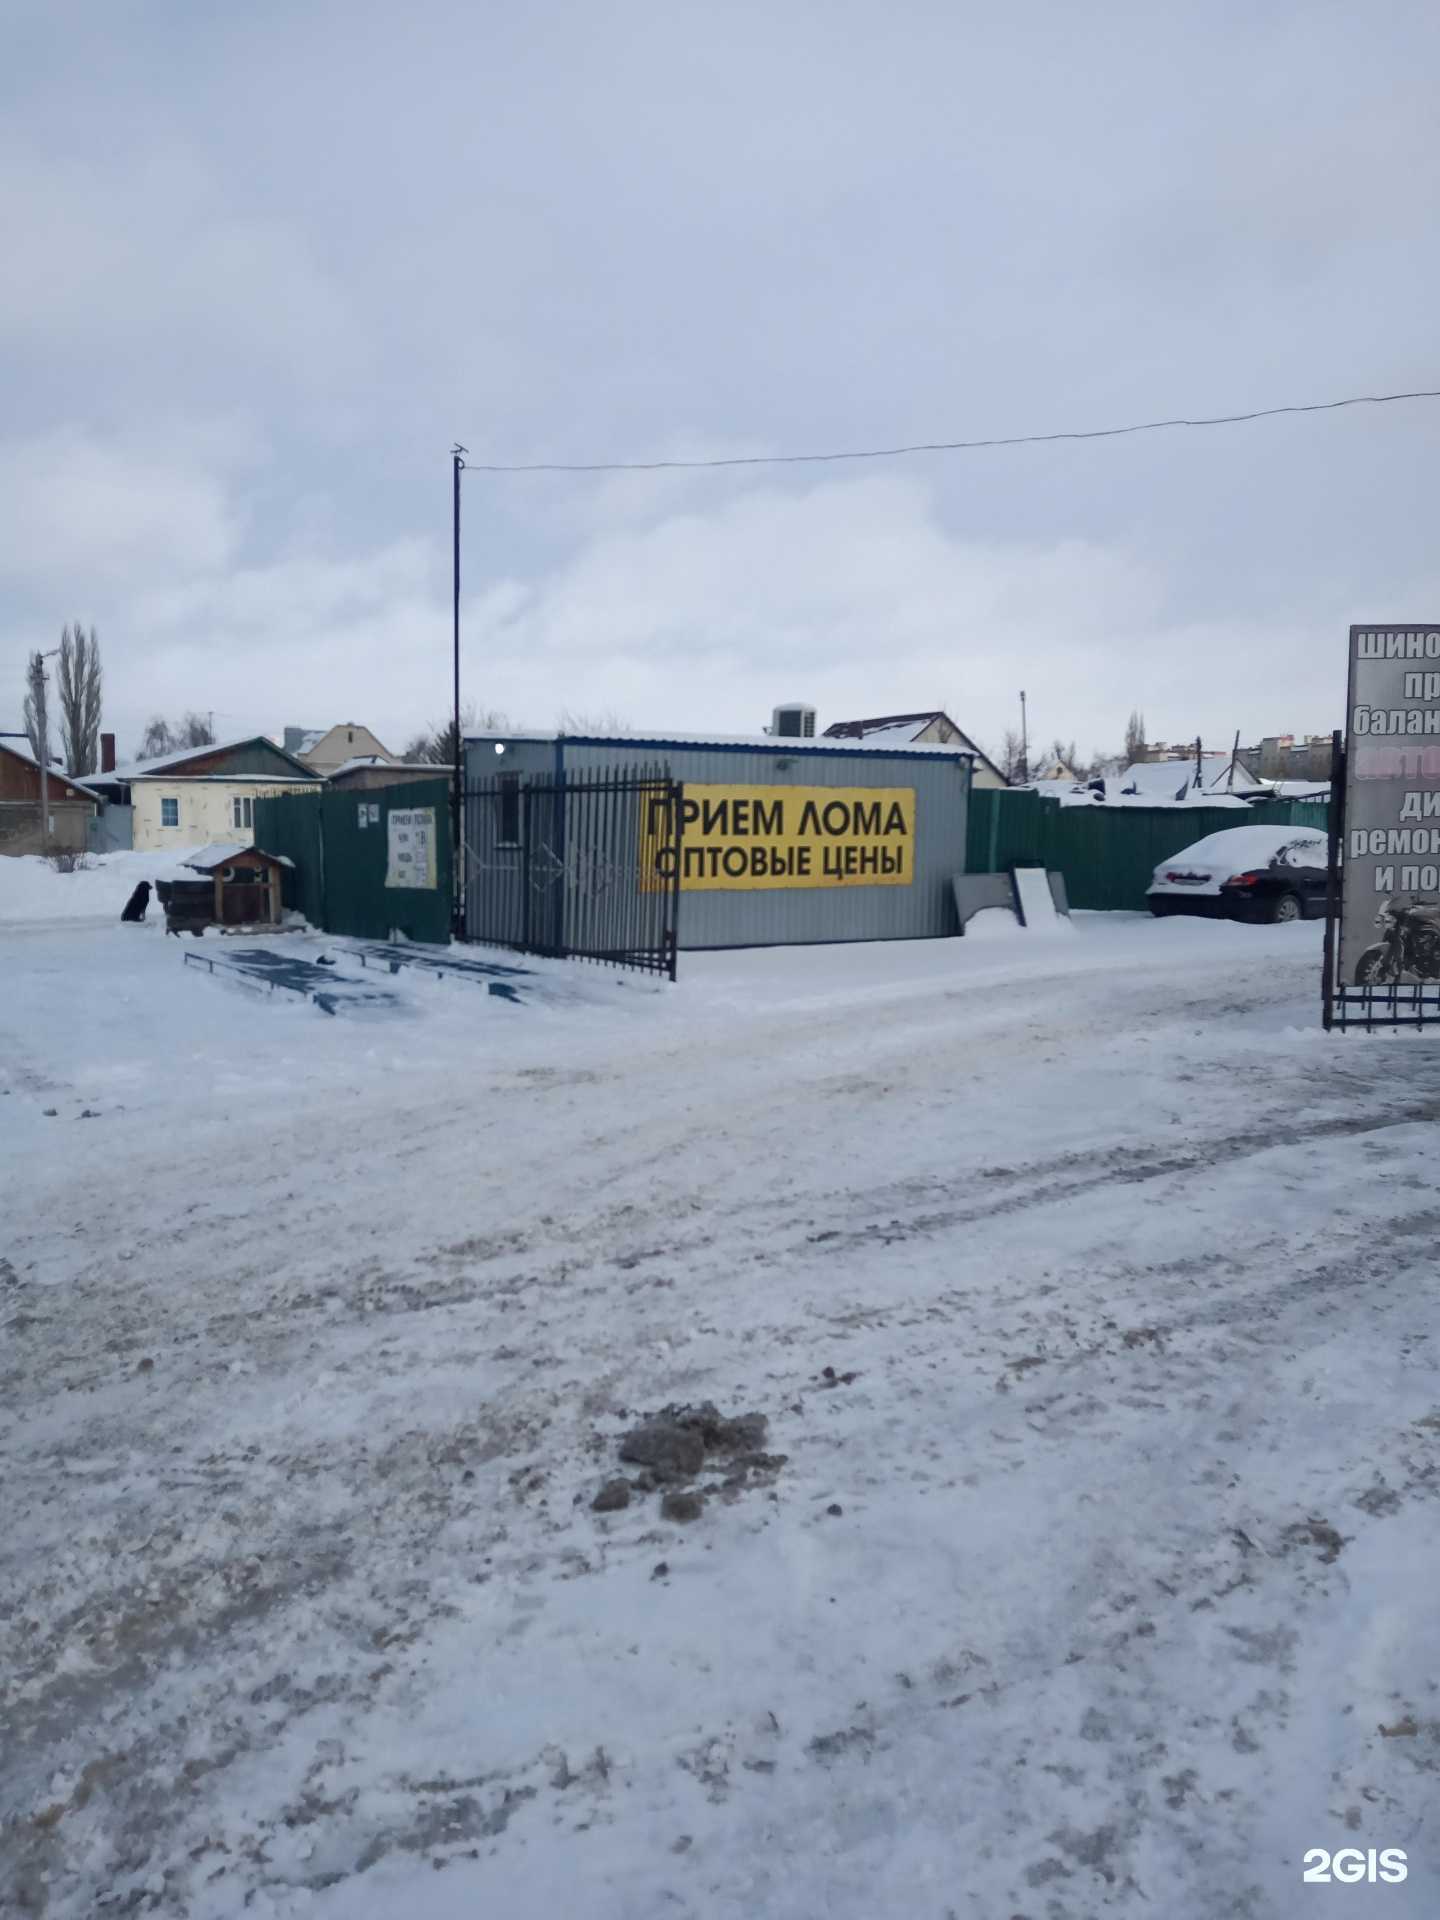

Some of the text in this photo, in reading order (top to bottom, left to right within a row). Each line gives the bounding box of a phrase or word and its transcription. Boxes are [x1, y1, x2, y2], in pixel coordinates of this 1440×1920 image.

[1357, 632, 1440, 659] шино
[1404, 672, 1440, 701] пр
[1353, 705, 1440, 735] балан
[648, 799, 907, 836] ПРИЕМ ЛОМА
[1400, 791, 1440, 821] ди
[654, 846, 903, 880] ОПТОВЫЕ ЦЕНЫ
[1375, 864, 1440, 892] и по
